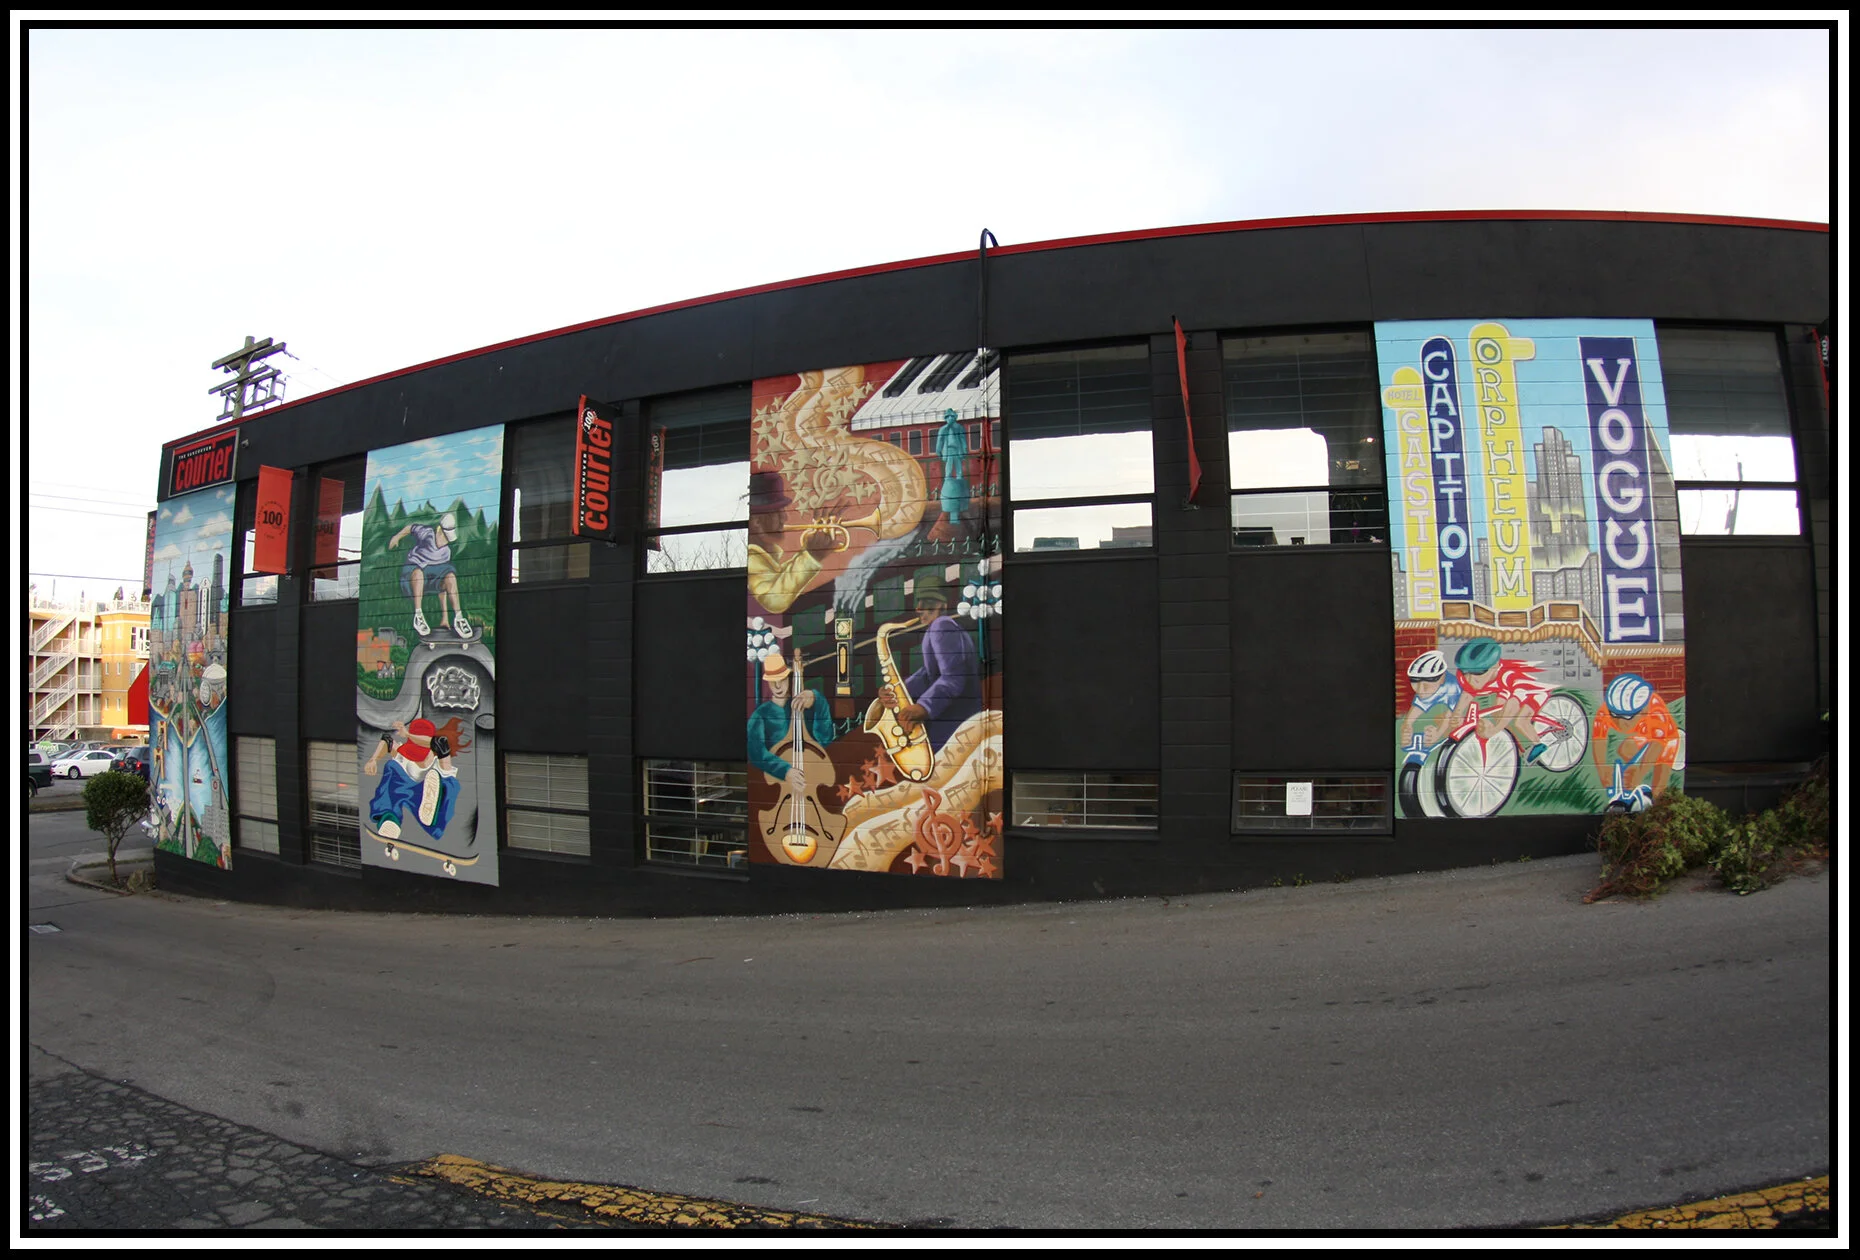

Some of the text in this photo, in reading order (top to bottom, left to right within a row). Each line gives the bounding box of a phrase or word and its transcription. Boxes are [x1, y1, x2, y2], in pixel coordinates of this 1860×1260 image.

[584, 411, 594, 430] 100
[1388, 388, 1421, 401] HOTEL
[175, 443, 232, 491] courier
[262, 510, 283, 526] 100
[584, 418, 612, 531] courier
[1400, 411, 1437, 612] CASTLE
[1423, 350, 1468, 595] CAPITOL
[1475, 338, 1529, 598] ORPHEUM
[1587, 358, 1650, 641] VOGUE
